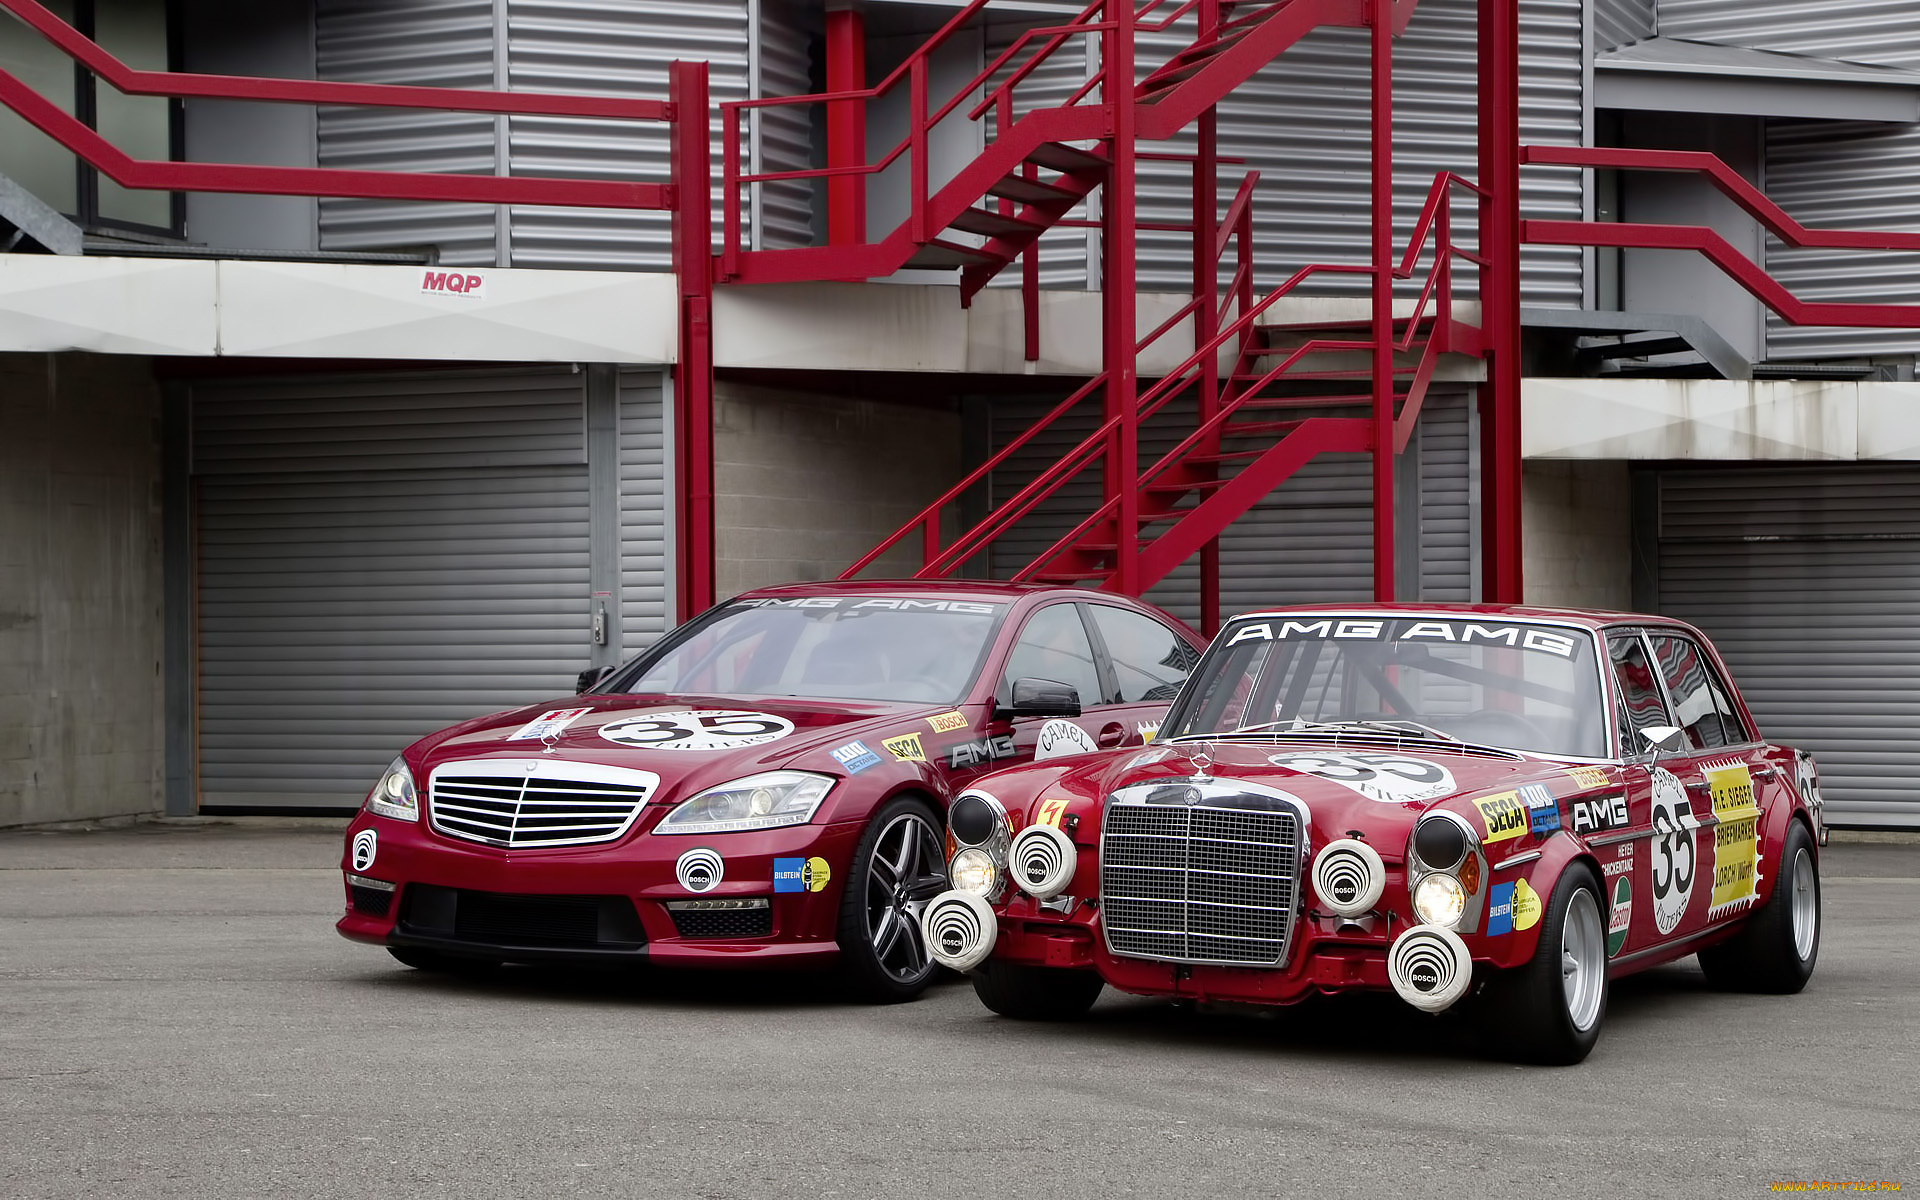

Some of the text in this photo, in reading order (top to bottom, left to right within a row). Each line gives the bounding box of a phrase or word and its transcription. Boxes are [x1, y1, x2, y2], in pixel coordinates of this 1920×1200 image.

[422, 271, 482, 293] MQP
[727, 598, 993, 614] AMG AMG
[1225, 620, 1575, 657] AMG AMG
[603, 713, 785, 743] 35
[935, 714, 967, 730] BOSCH
[888, 739, 922, 759] SECA
[1041, 723, 1089, 752] CAMEL
[833, 741, 869, 763] 100
[951, 735, 1016, 769] AMG
[1274, 755, 1444, 783] 35
[1712, 784, 1752, 810] H.E. SIEGER
[1480, 797, 1525, 833] SECA
[1573, 796, 1629, 832] AMG
[1717, 820, 1754, 847] BRIEFMARKEN
[1652, 802, 1694, 900] 35
[774, 871, 801, 879] BILSTEIN
[1027, 867, 1046, 875] BOSCH
[1489, 903, 1511, 917] BILSTEIN
[1656, 895, 1687, 930] FILTERS
[942, 938, 963, 947] BOSCH
[1412, 974, 1437, 983] BOSCH
